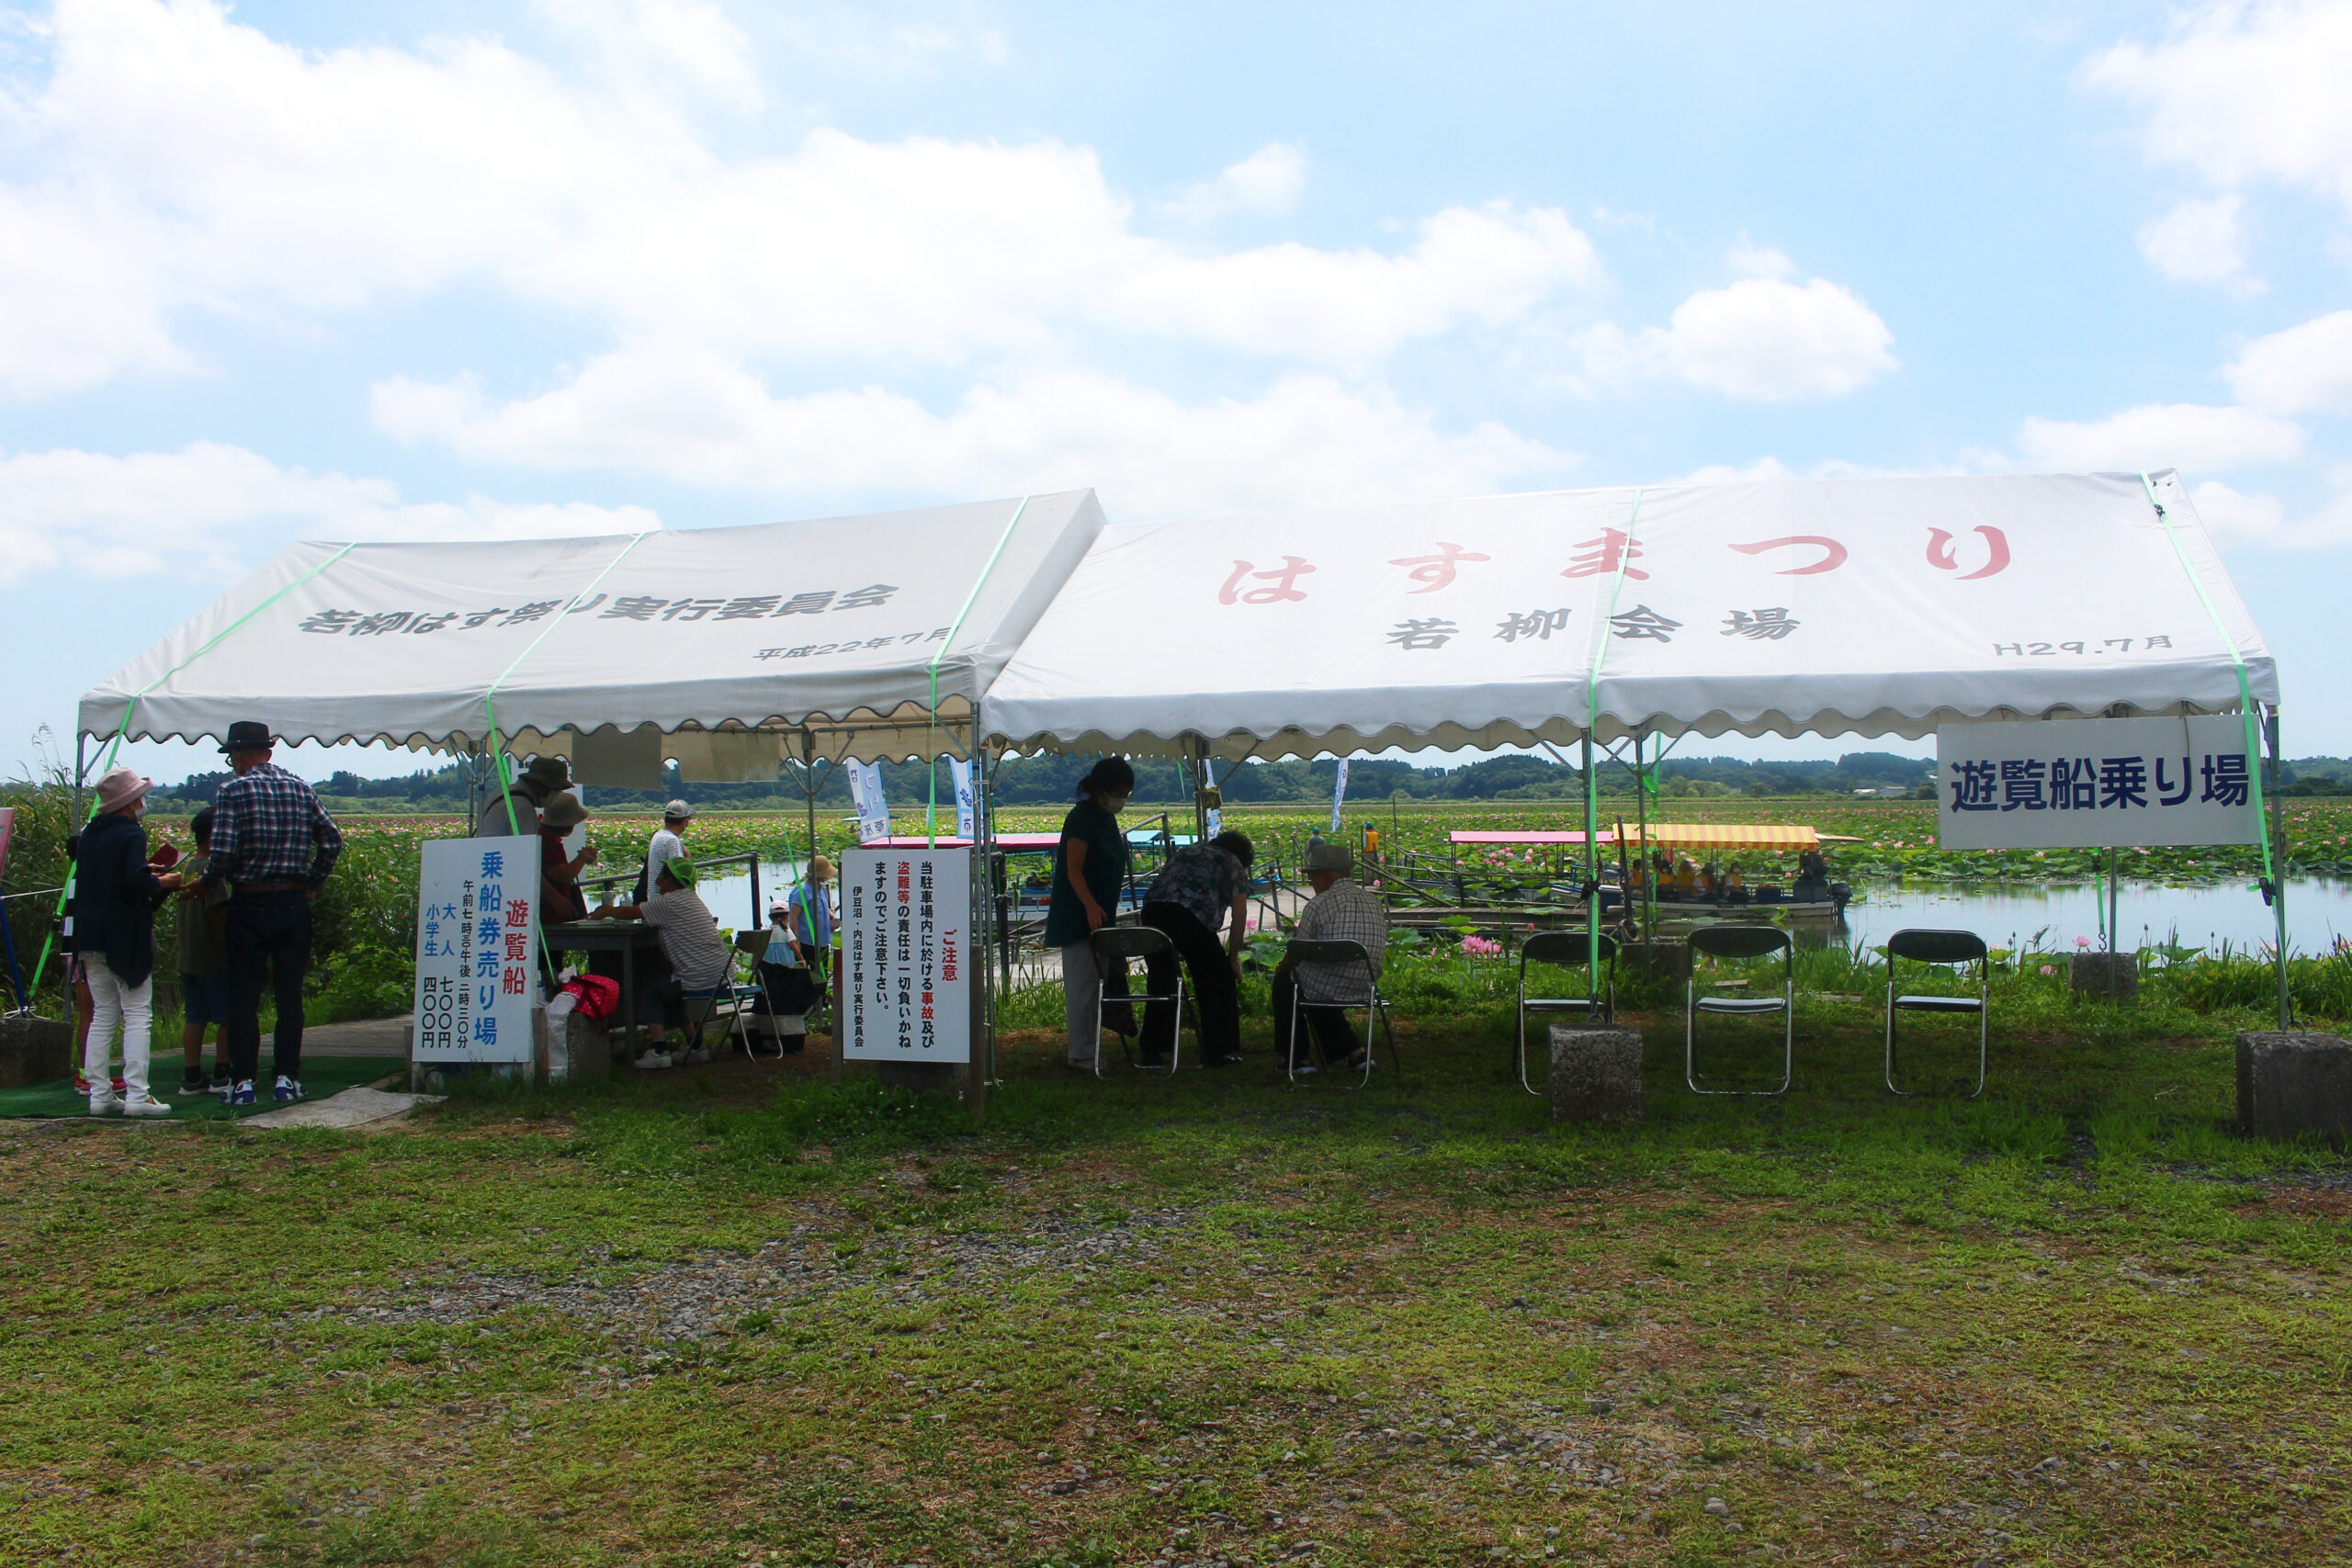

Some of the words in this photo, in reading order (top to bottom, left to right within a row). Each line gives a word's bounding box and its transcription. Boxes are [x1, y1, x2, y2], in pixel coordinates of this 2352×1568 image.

[1217, 525, 2012, 605] はすまつり
[299, 584, 899, 636] 若柳はす祭り実行委員会
[1385, 604, 1801, 650] 若柳会場
[1992, 635, 2173, 656] H29.7月
[1951, 754, 2249, 814] 遊覧船乗り場
[424, 903, 440, 957] 小学生
[473, 851, 504, 1045] 乗船券売り場
[503, 899, 529, 995] 遊覧船
[875, 862, 888, 1010] ますのでご注意下さい。
[897, 862, 911, 1048] 盗難等の責任は一切負いかね
[920, 862, 934, 1048] 当駐車場内に於ける事故及び
[942, 929, 957, 981] ご注意
